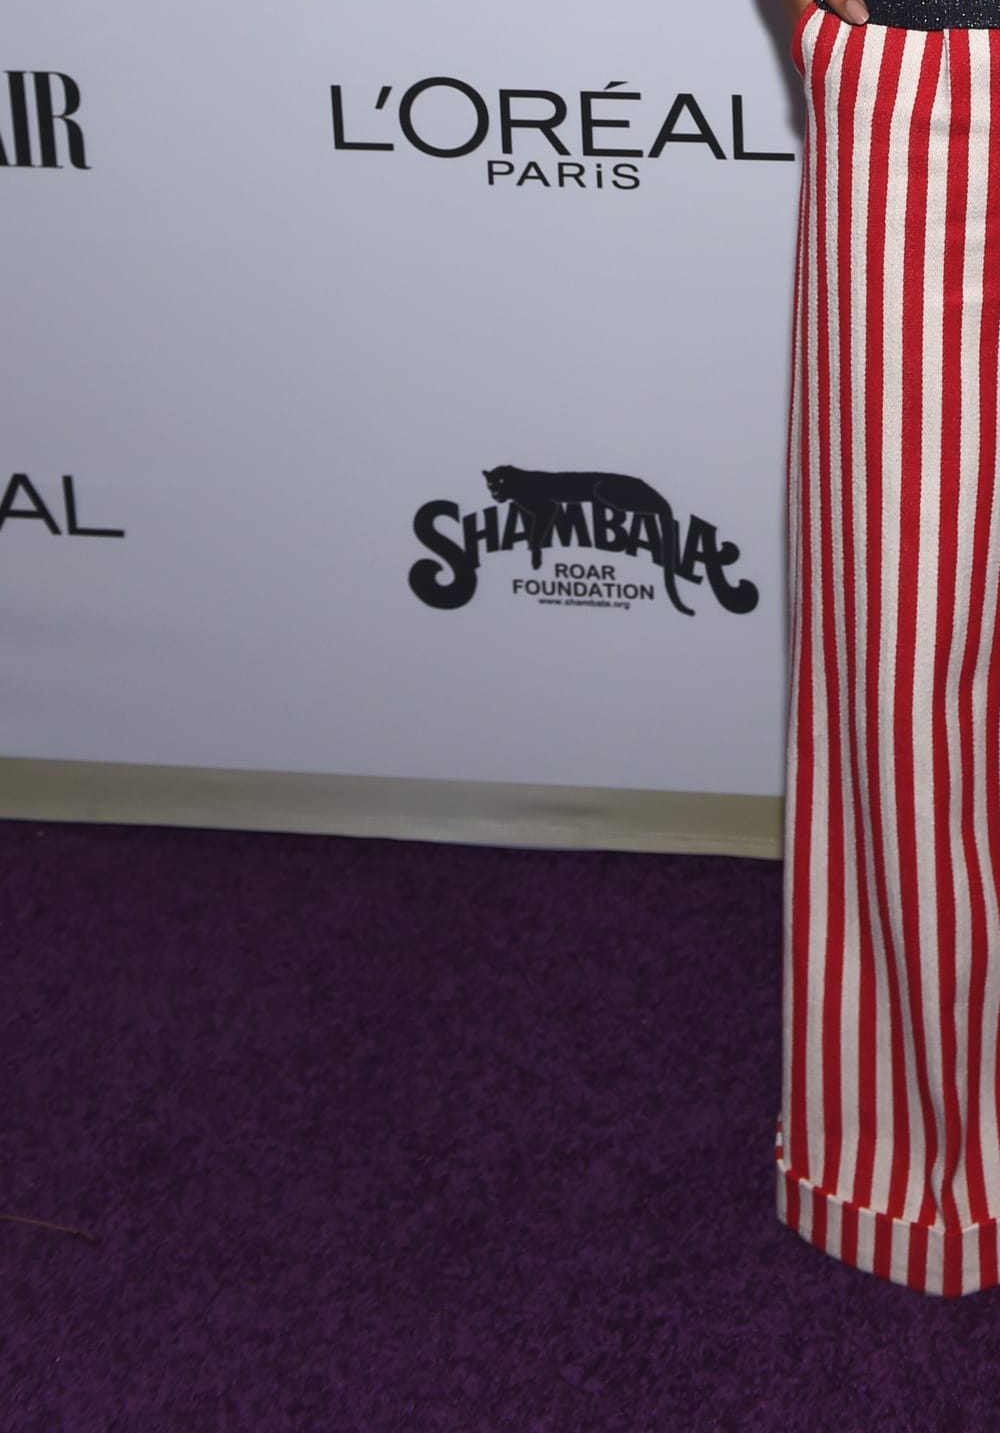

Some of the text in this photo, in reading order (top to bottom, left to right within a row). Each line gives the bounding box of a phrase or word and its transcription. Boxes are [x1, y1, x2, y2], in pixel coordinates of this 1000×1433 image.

[330, 76, 795, 161] L'ORÉAL
[408, 499, 759, 614] SHAMBALA
[554, 563, 616, 581] ROAR
[512, 579, 655, 600] FOUNDATION
